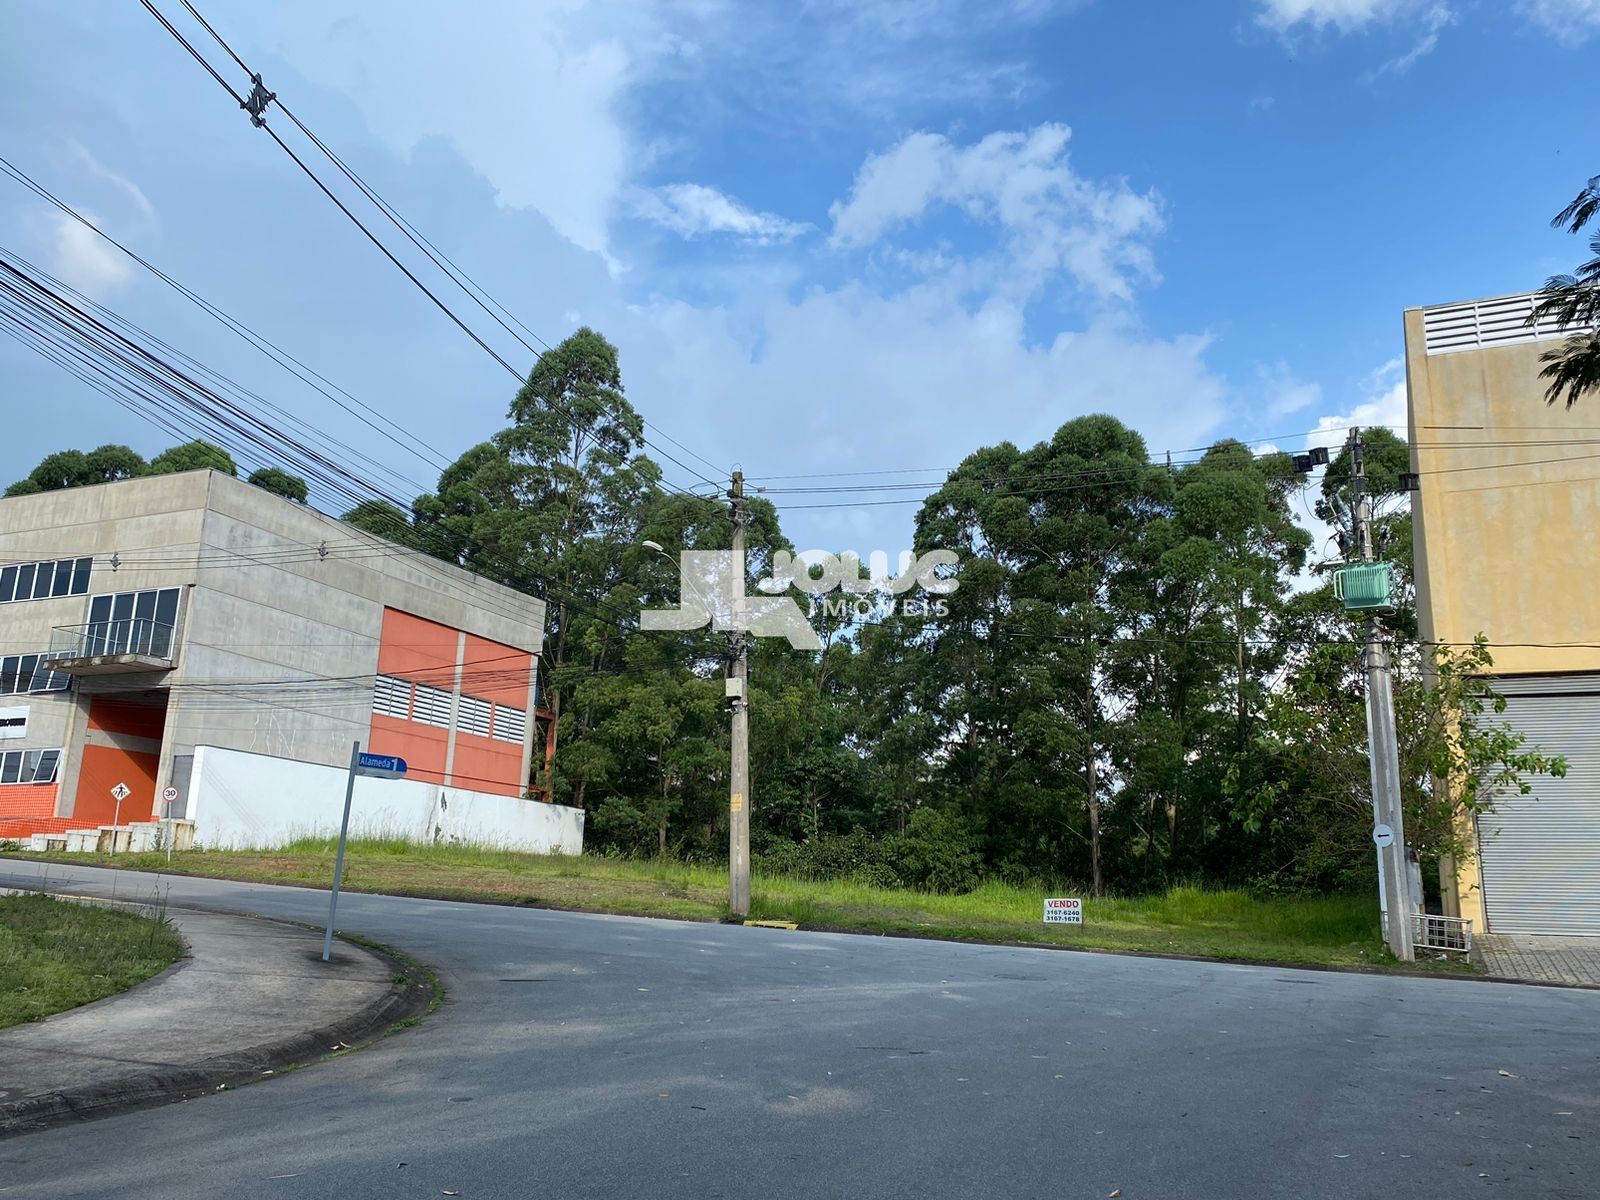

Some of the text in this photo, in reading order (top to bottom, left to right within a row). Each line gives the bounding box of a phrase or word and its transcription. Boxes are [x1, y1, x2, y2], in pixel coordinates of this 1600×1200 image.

[360, 757, 398, 771] Alameda 1
[1048, 900, 1079, 908] VENDO
